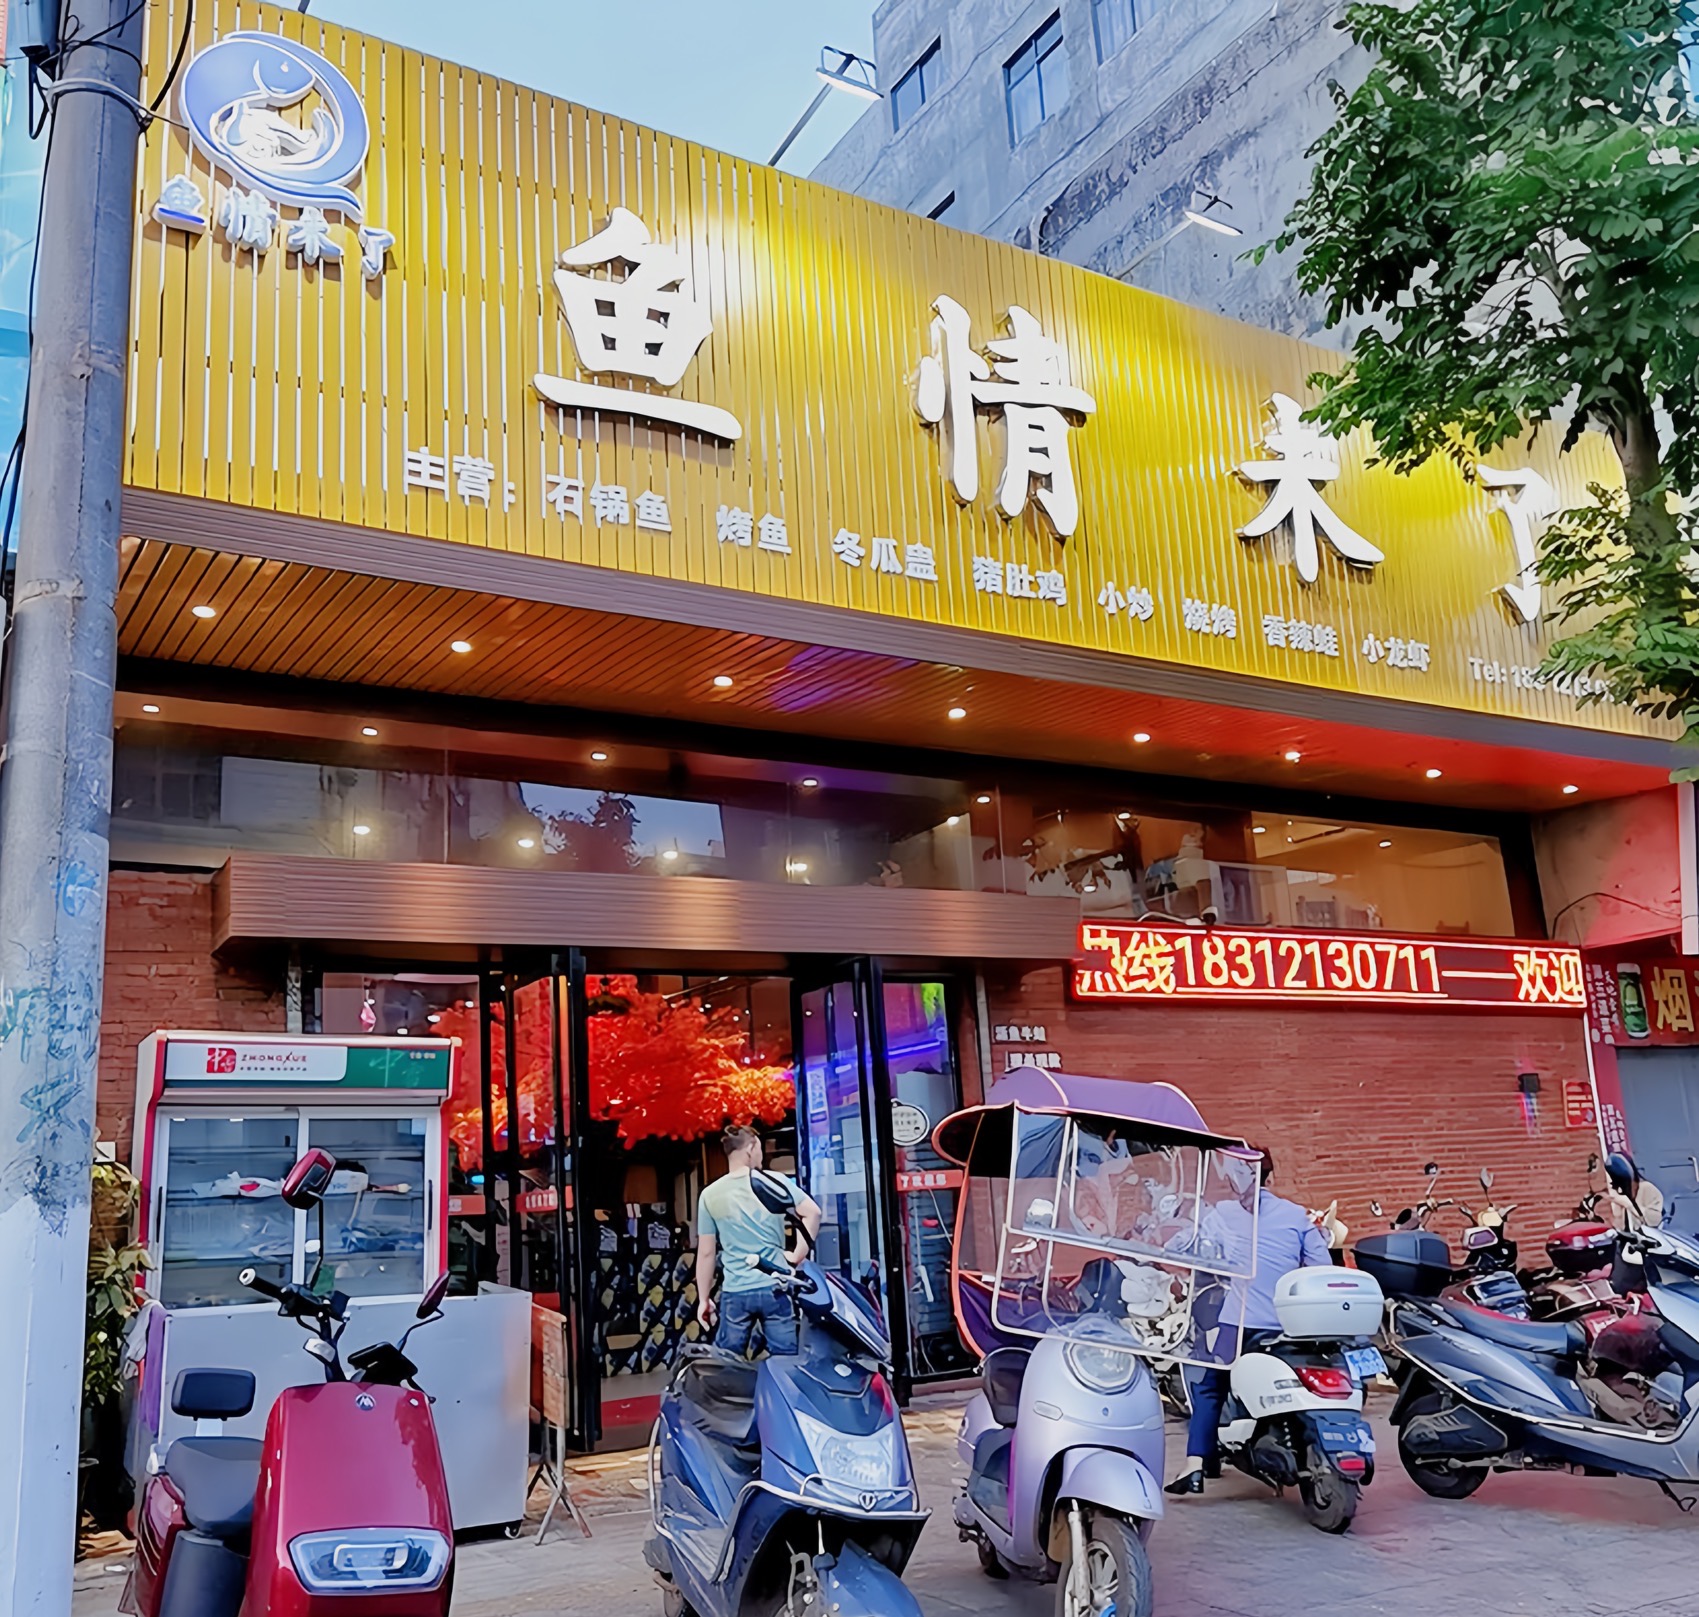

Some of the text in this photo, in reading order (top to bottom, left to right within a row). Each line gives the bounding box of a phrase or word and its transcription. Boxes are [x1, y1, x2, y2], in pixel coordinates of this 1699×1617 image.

[546, 474, 672, 532] 石锅鱼
[715, 505, 792, 555] 烤鱼
[972, 556, 1067, 606] 猪肚鸡
[1098, 581, 1154, 621] 小炒
[1182, 597, 1238, 639] 烧烤
[1263, 614, 1340, 657] 香辣蛙
[1361, 633, 1431, 672] 小龙虾
[1650, 965, 1699, 1033] 烟
